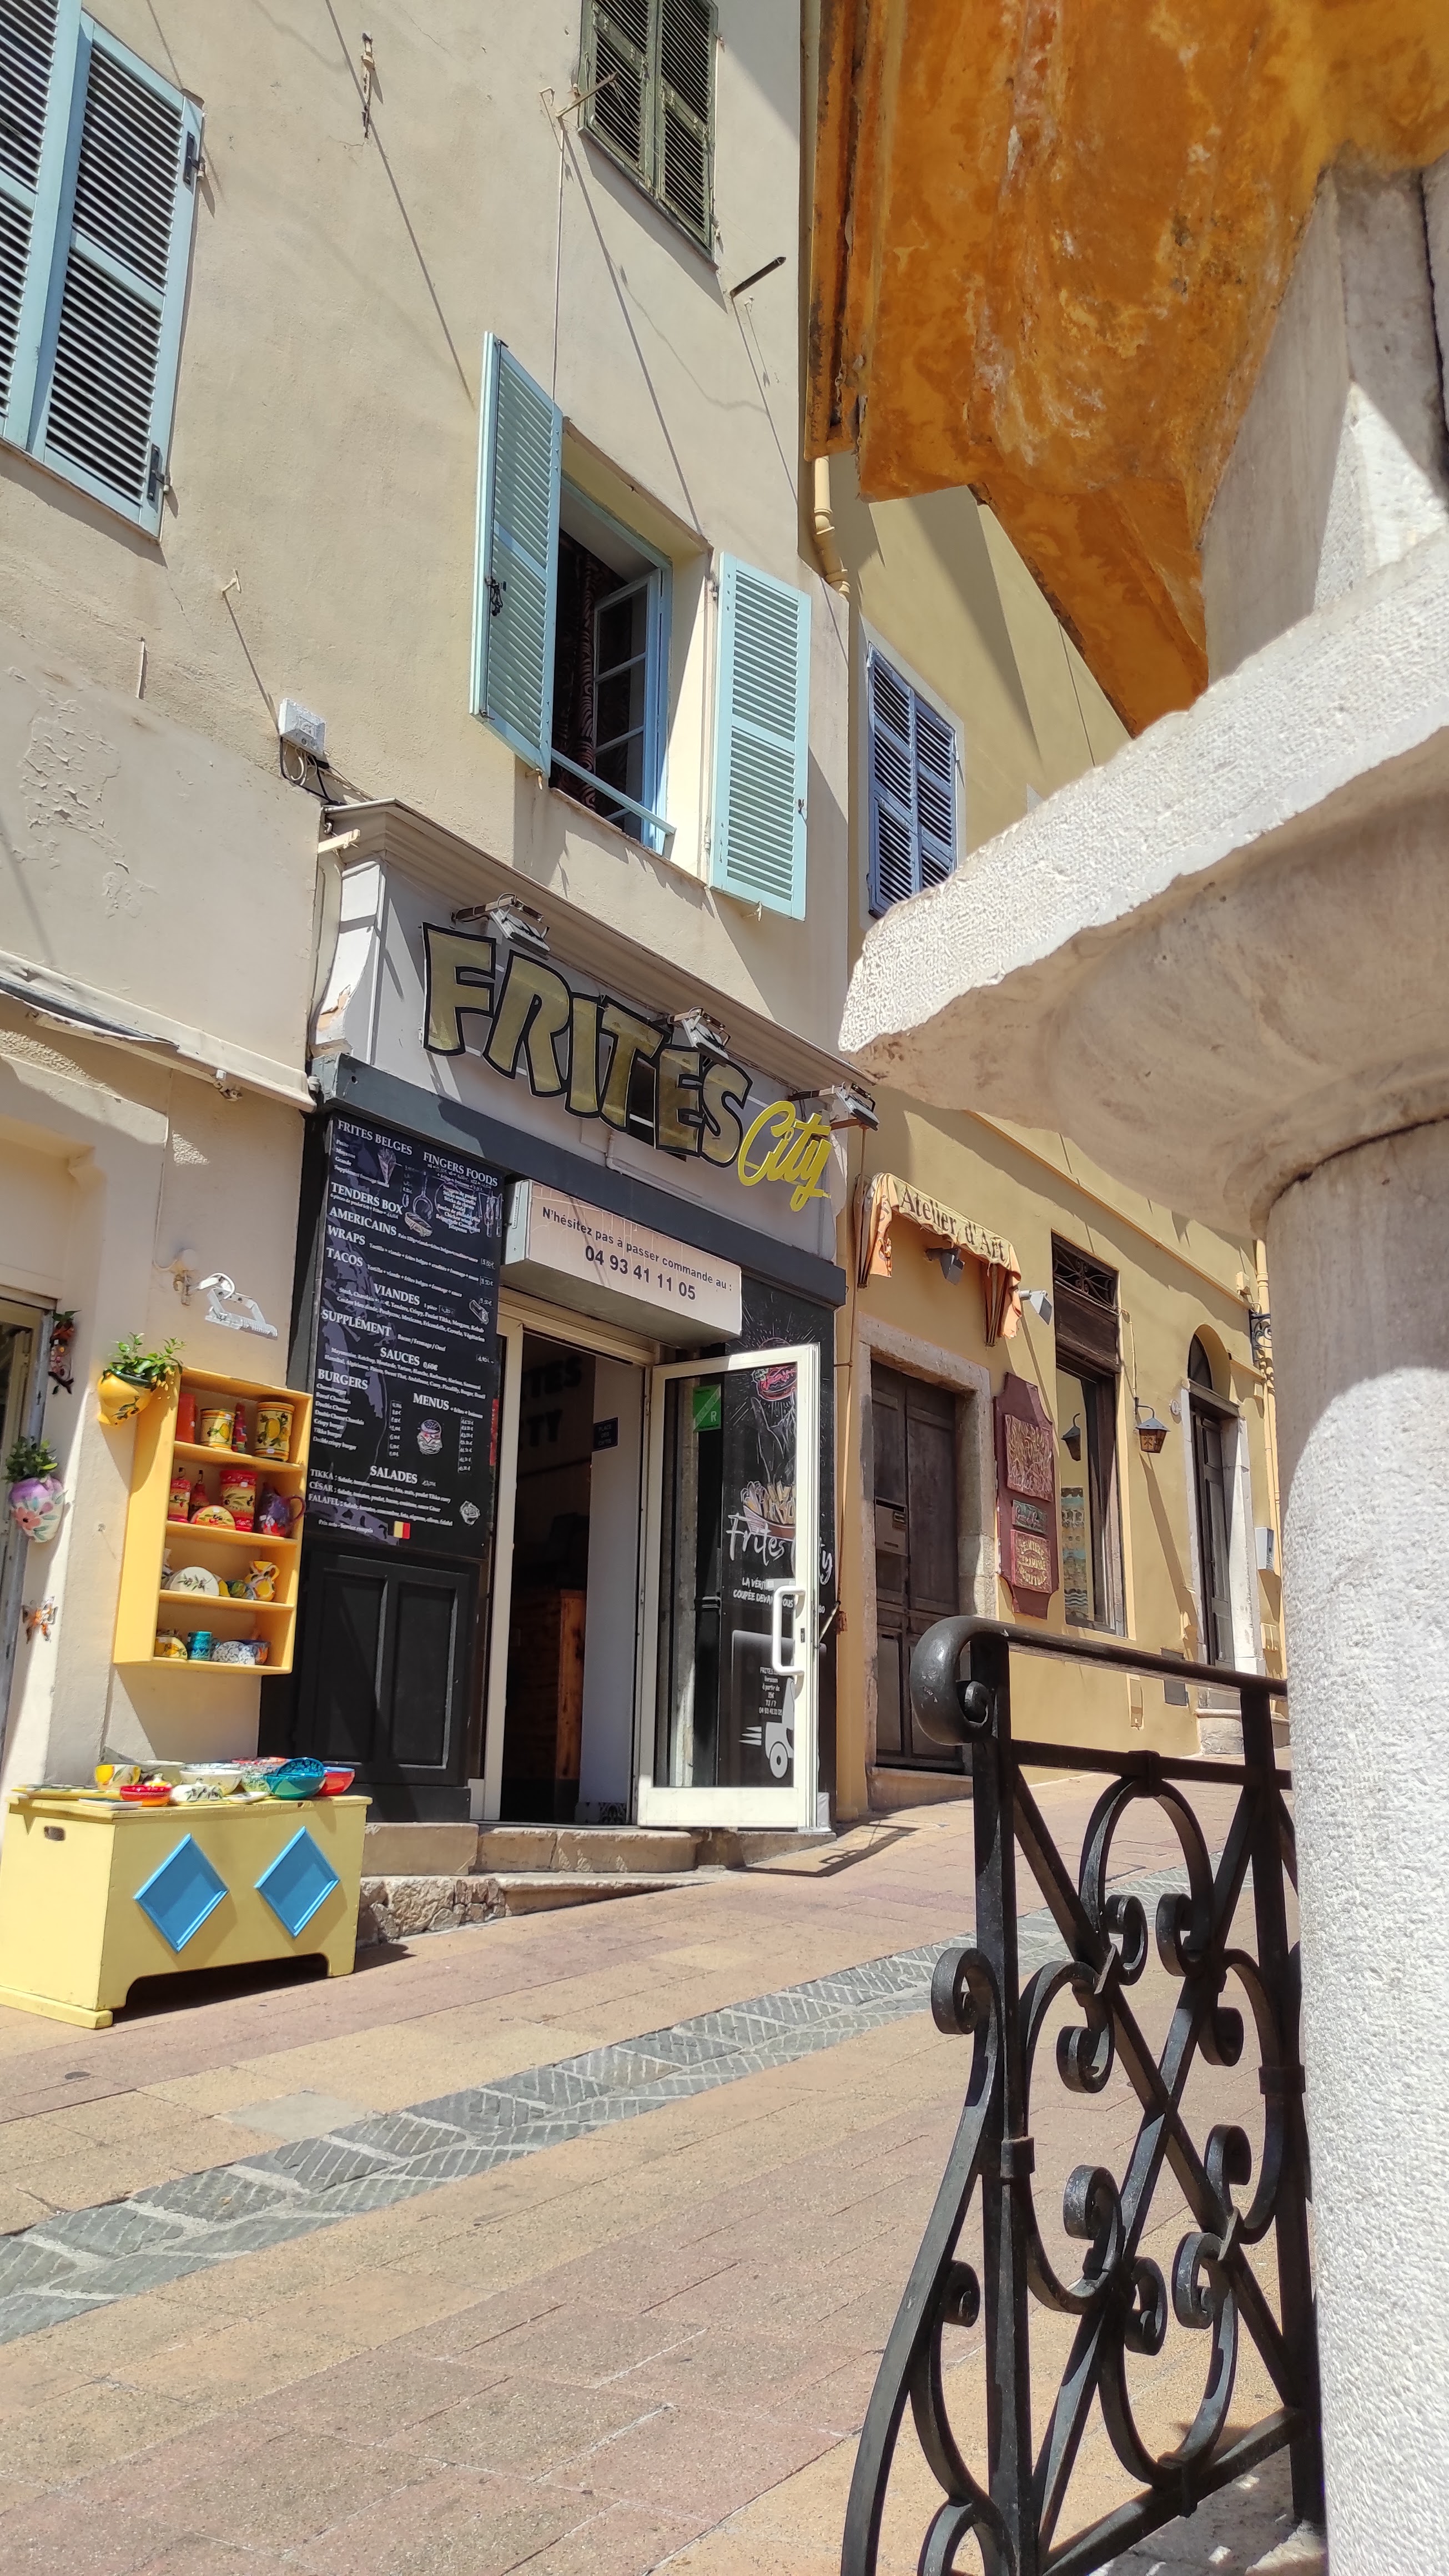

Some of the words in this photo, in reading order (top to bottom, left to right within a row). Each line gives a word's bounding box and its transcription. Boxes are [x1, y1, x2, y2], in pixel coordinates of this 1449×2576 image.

[422, 922, 753, 1168] FRITES
[738, 1100, 832, 1212] City
[338, 1119, 373, 1141] FRITES
[375, 1133, 412, 1155] BELGES
[423, 1151, 464, 1175] FINGERS
[466, 1166, 497, 1187] FOODS
[330, 1181, 380, 1207] TENDERS
[381, 1198, 403, 1215] BOX
[329, 1205, 396, 1236] AMERICAINS
[899, 1185, 957, 1236] Atelier
[965, 1221, 1005, 1262] d'Art
[327, 1224, 365, 1246] WRAPS
[325, 1246, 363, 1267] TACOS
[542, 1206, 592, 1236] N'hésitez
[596, 1230, 613, 1245] pas
[617, 1237, 623, 1247] à
[626, 1242, 660, 1263] passer
[662, 1257, 713, 1284] commande
[716, 1277, 727, 1290] au
[585, 1245, 603, 1266] 04
[610, 1255, 628, 1274] 93
[633, 1265, 650, 1283] 41
[657, 1274, 672, 1292] 11
[678, 1282, 696, 1300] 05
[373, 1283, 420, 1306] VIANDES
[321, 1306, 392, 1337] SUPPLÉMENT
[380, 1347, 420, 1366] SAUCES
[317, 1368, 368, 1390] BURGERS
[412, 1392, 449, 1410] MENUS
[310, 1468, 334, 1480] TIKKA
[370, 1465, 417, 1484] SALADES
[309, 1479, 334, 1492] CÉSAR
[308, 1493, 339, 1506] FALAFEL
[726, 1513, 787, 1567] Frites
[742, 1577, 749, 1588] LA
[733, 1589, 755, 1601] COUPÉE
[782, 1598, 793, 1608] OUS
